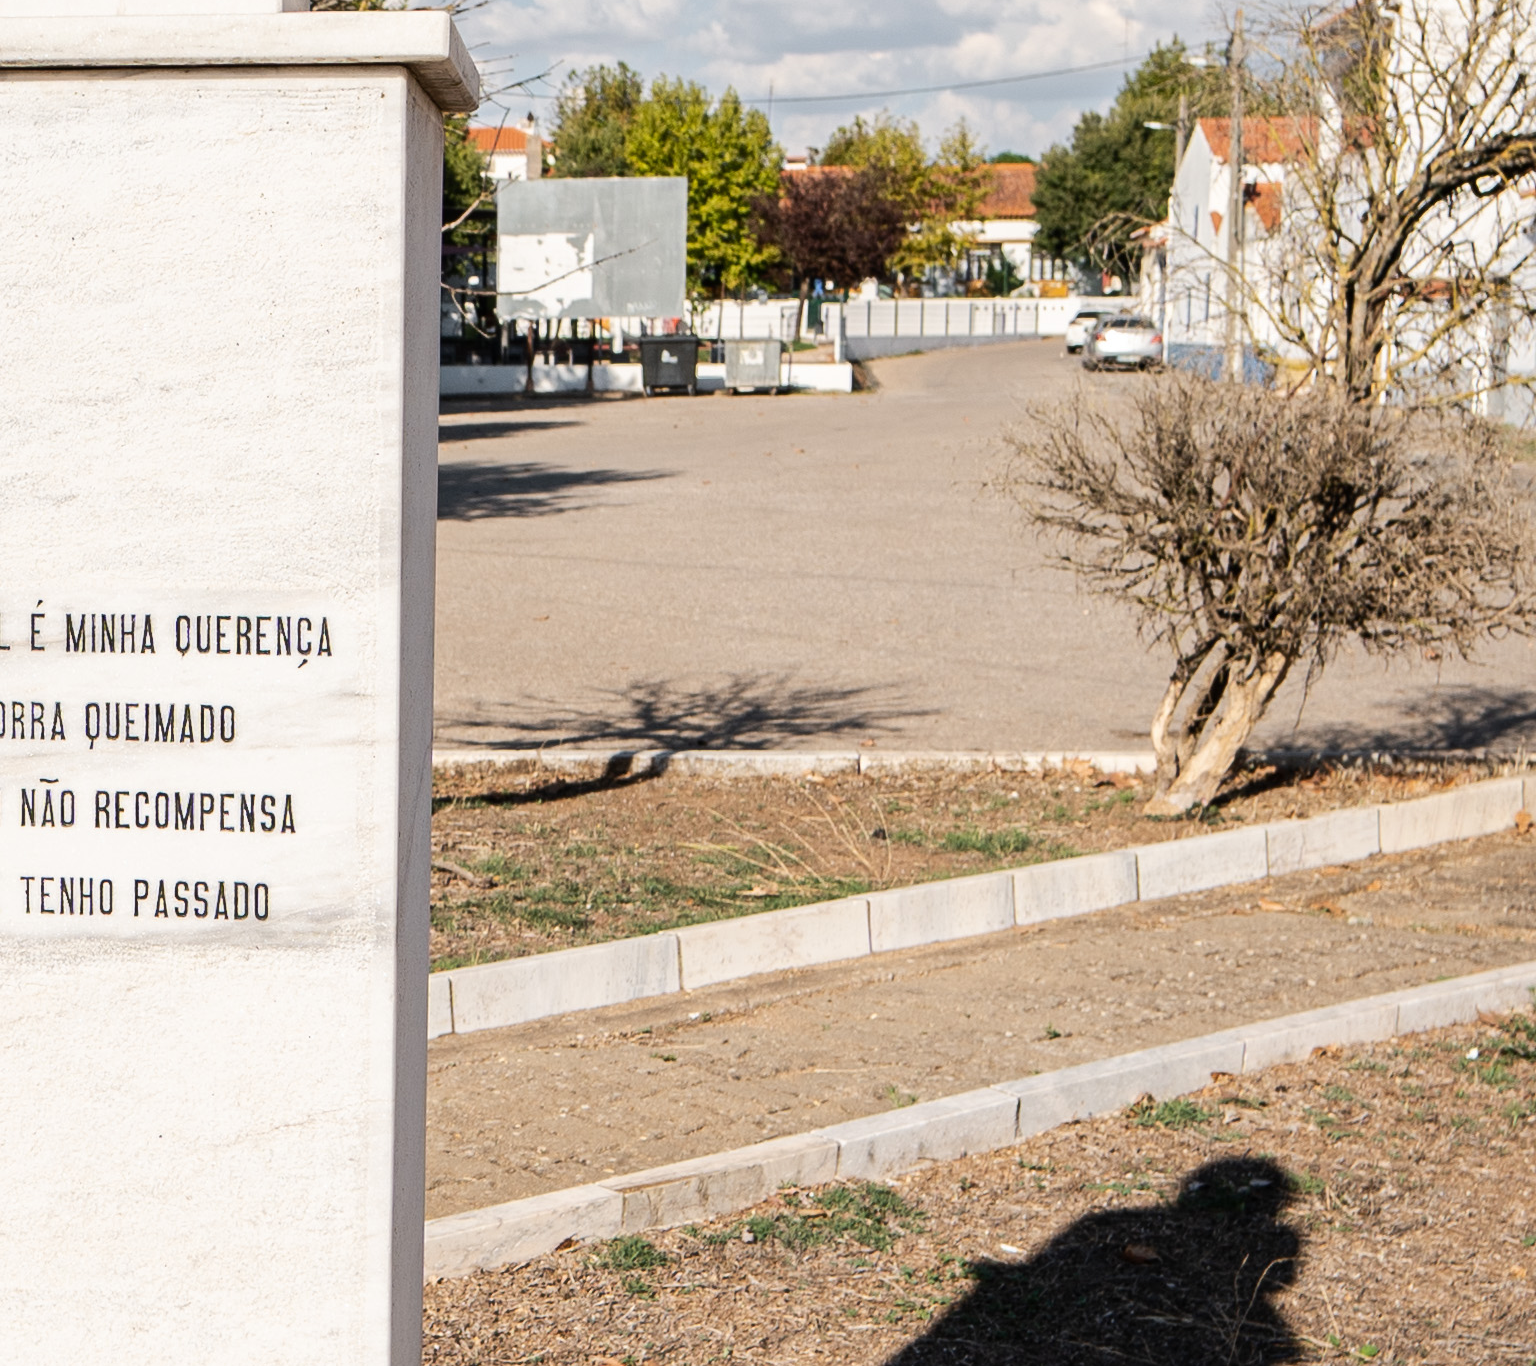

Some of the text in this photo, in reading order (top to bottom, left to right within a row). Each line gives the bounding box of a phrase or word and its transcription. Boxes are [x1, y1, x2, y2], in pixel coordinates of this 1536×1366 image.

[30, 599, 46, 652] É
[65, 613, 156, 654] MINHA
[175, 614, 333, 669] QUERENÇA
[84, 701, 236, 751] QUEIMADO
[20, 778, 75, 828] NÃO
[94, 790, 296, 834] RECOMPENSA
[19, 876, 114, 916] TENHO
[133, 878, 269, 922] PASSADO
